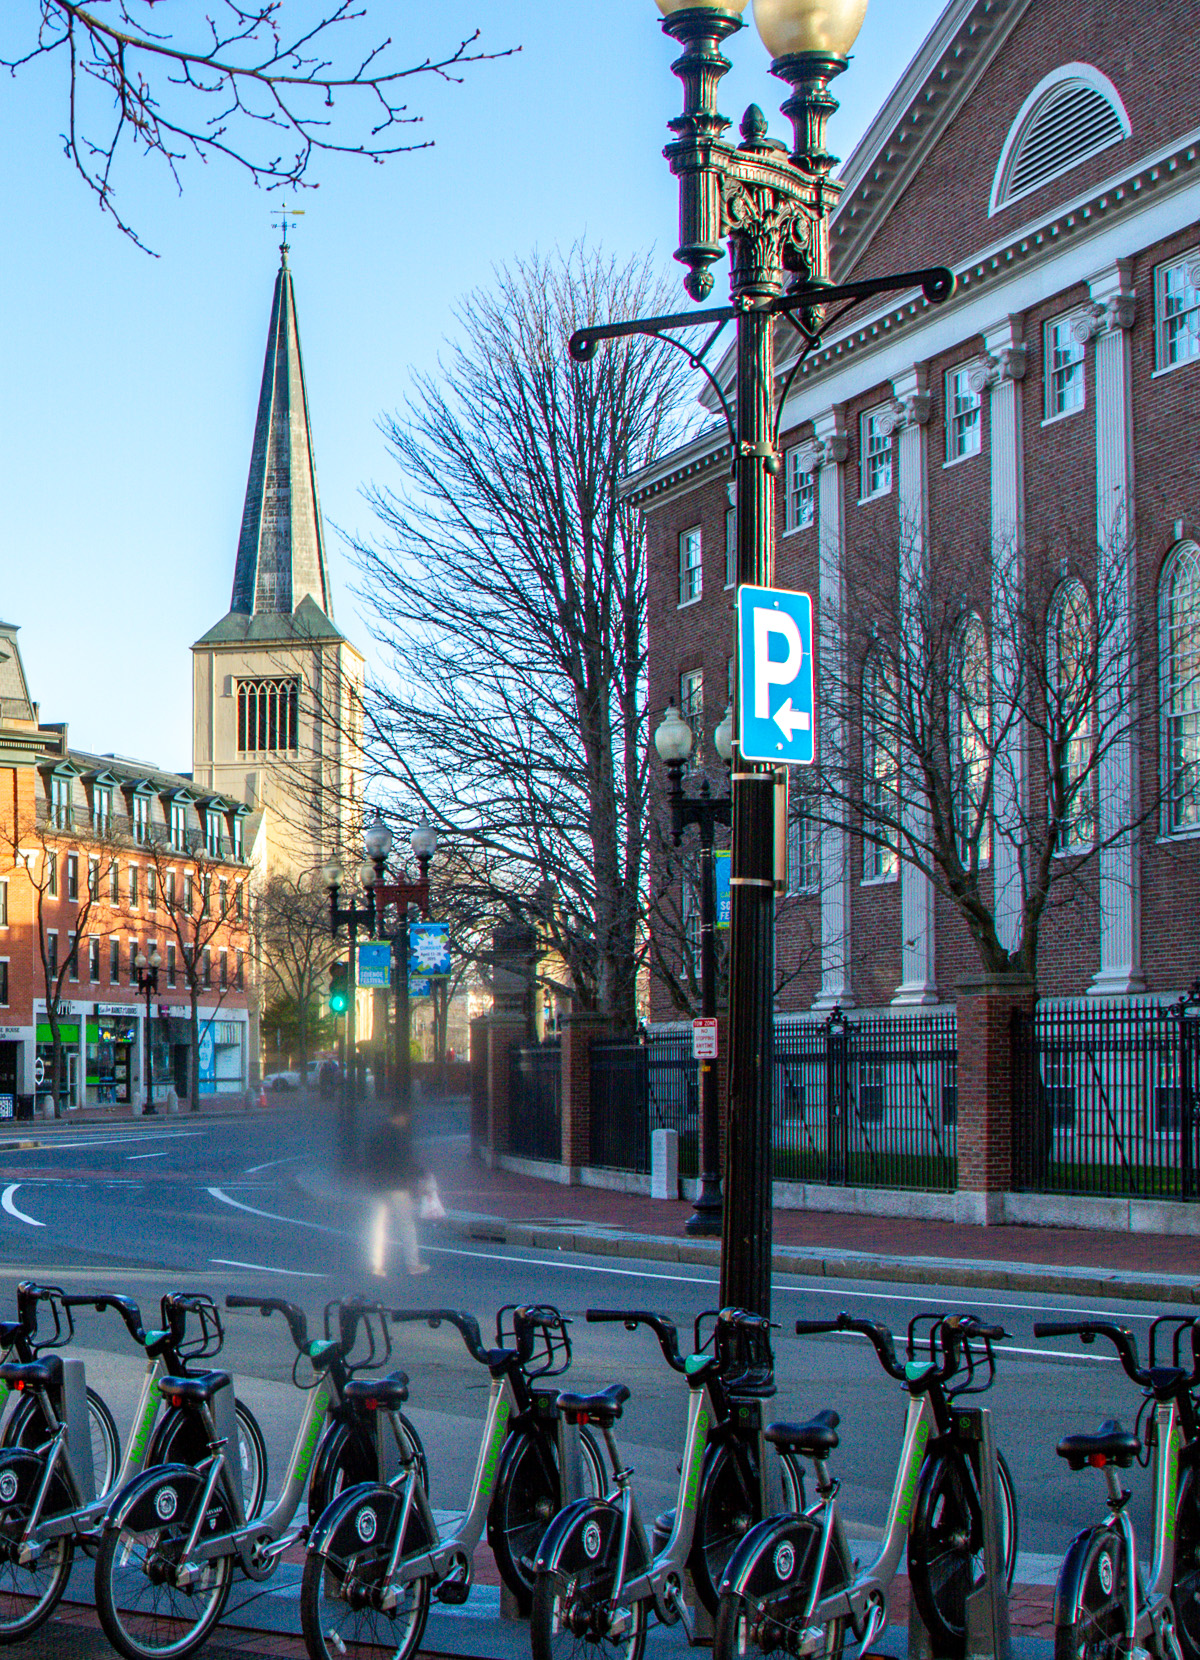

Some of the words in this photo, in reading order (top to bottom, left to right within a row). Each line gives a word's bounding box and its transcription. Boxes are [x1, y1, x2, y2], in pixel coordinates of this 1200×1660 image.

[753, 607, 803, 719] P
[129, 1398, 159, 1463] Hubway
[294, 1411, 324, 1481] Hubway
[479, 1422, 506, 1495] Hubway
[684, 1431, 707, 1510] Hubway
[896, 1443, 925, 1524] Hubway
